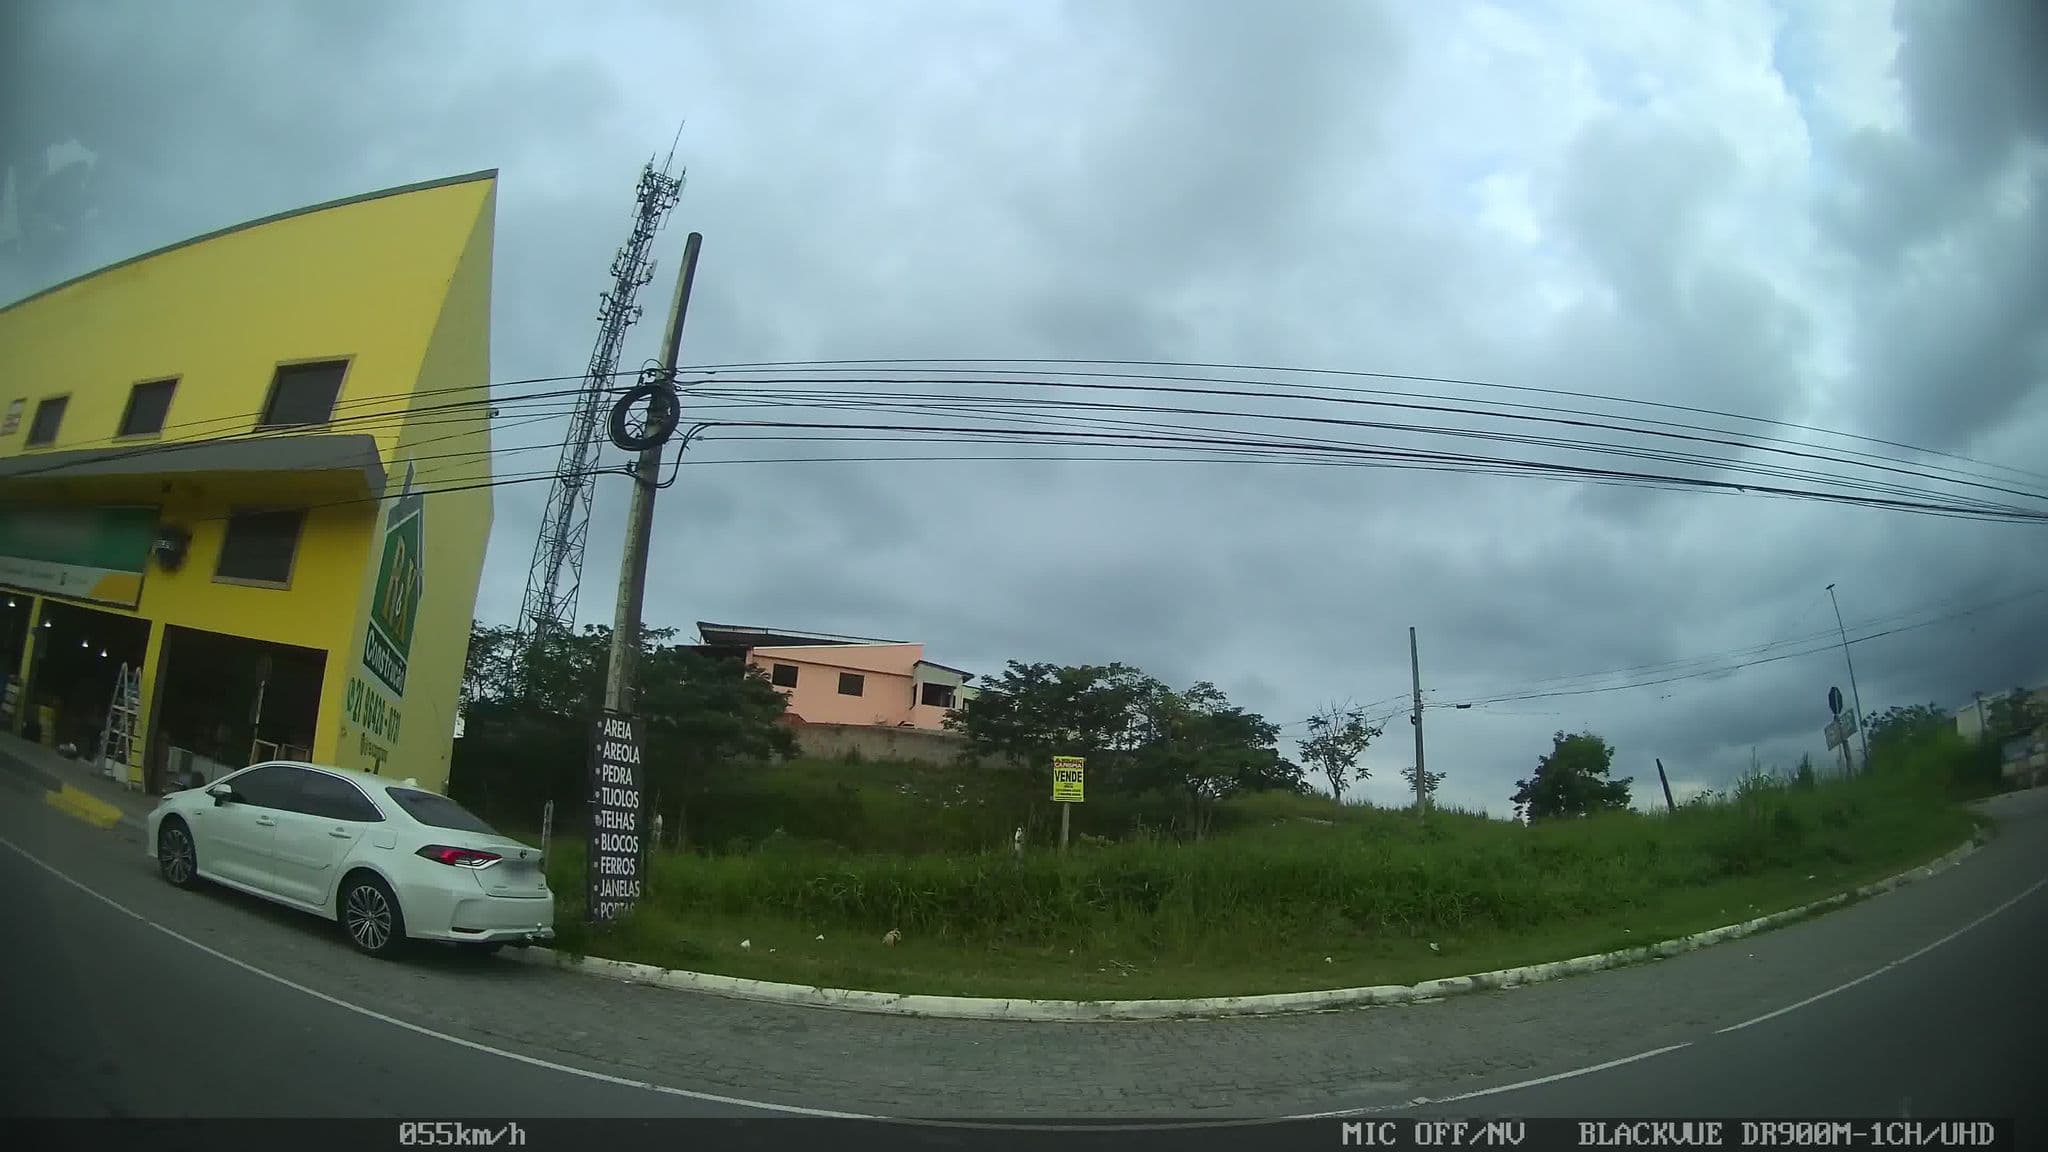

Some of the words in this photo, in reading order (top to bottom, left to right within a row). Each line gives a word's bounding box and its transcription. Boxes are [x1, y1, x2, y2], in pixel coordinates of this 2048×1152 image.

[603, 717, 632, 741] AREIA
[603, 741, 640, 764] AREOLA
[602, 763, 633, 786] PEDRA
[1055, 770, 1082, 783] VENDE
[601, 787, 639, 809] TIJOLOS
[601, 809, 635, 831] TELHAS
[601, 833, 639, 854] BLOCOS
[600, 856, 636, 876] FERROS
[600, 879, 640, 898] JANELAS
